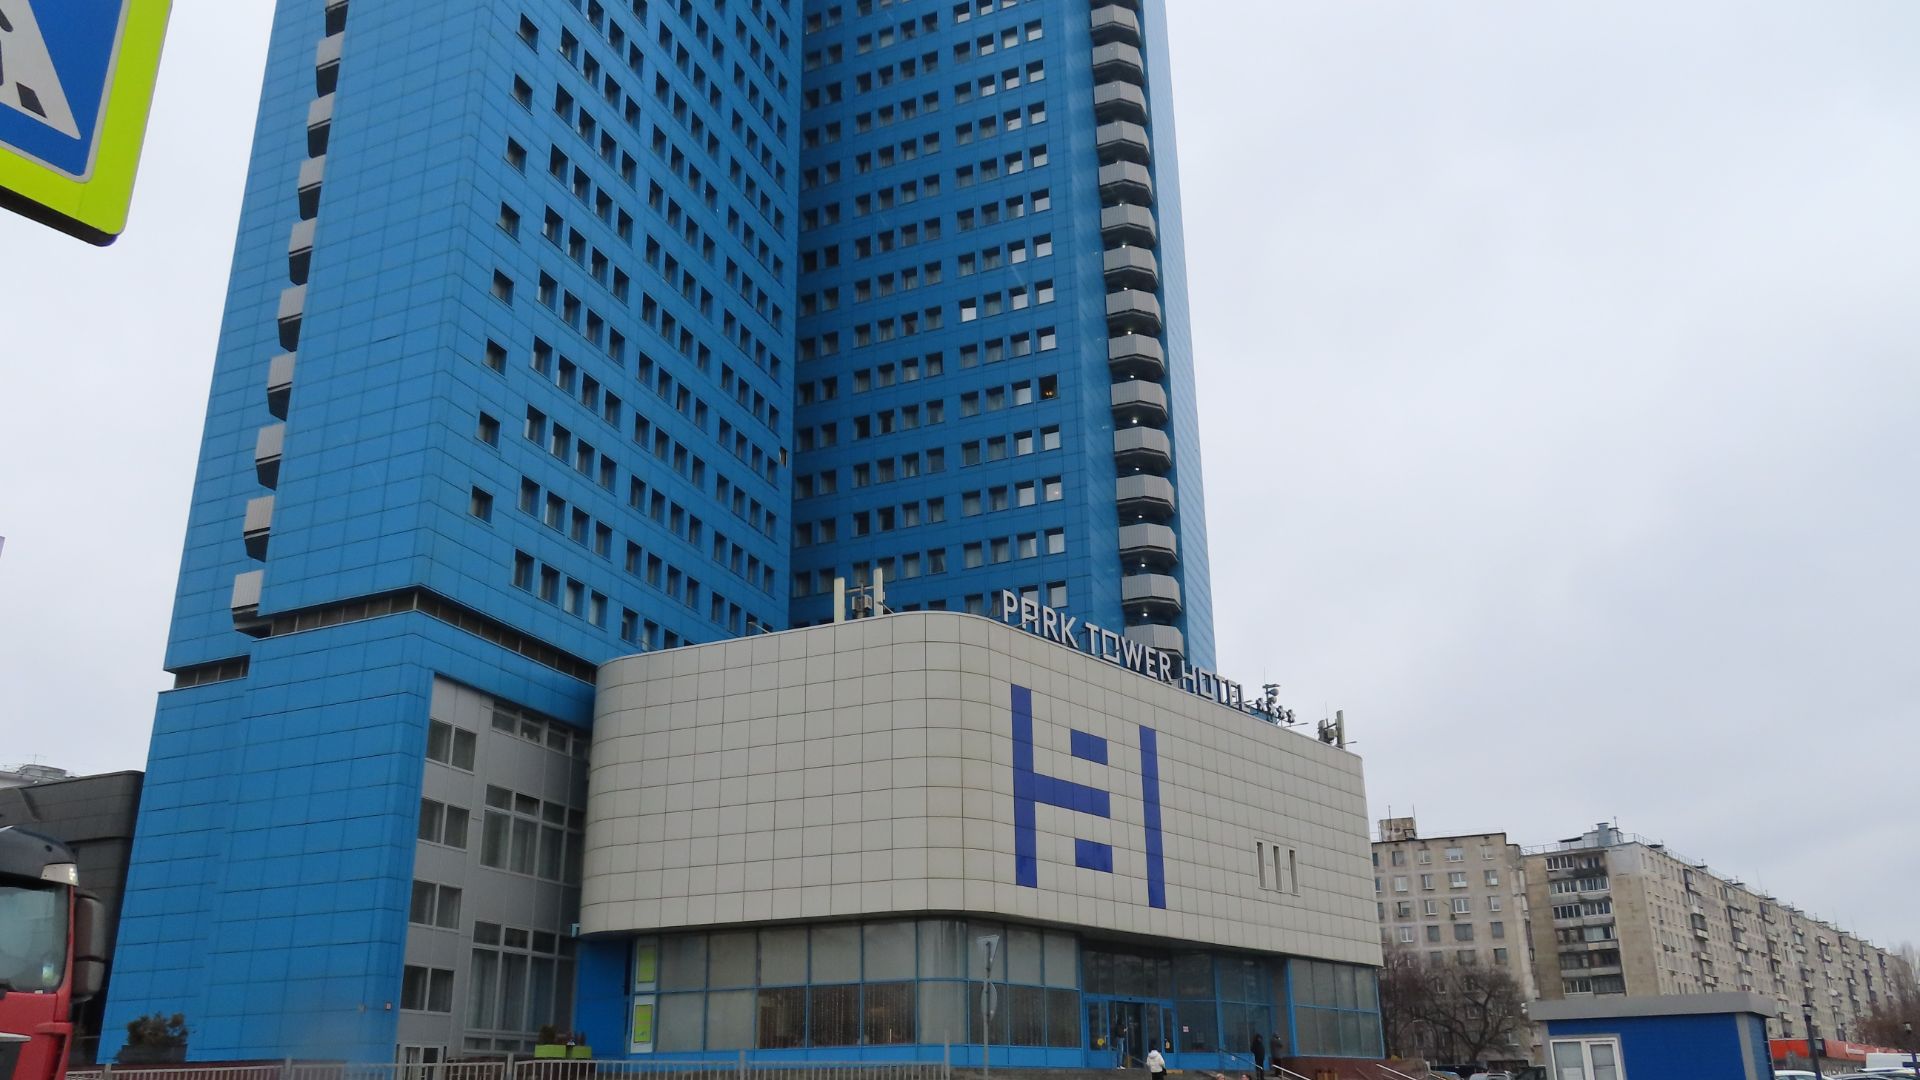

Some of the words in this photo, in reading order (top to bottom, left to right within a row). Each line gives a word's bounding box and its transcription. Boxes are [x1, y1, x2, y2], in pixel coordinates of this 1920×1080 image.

[1003, 589, 1078, 649] PARK
[1085, 621, 1172, 685] TOWER
[1180, 659, 1252, 714] HOTEL
